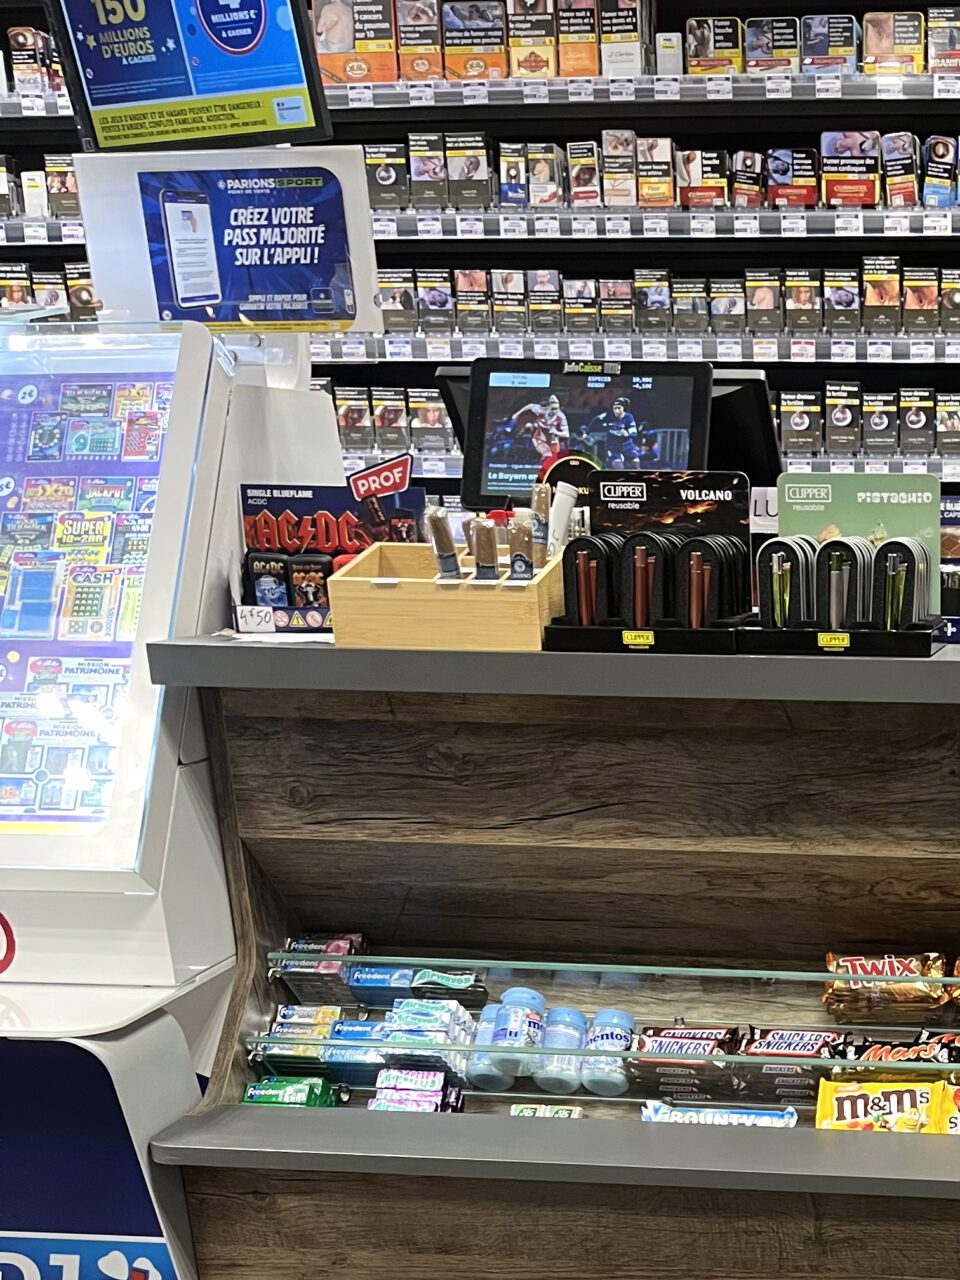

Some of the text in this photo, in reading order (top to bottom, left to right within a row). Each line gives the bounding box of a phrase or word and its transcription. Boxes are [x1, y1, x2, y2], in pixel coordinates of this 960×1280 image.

[211, 11, 249, 23] MILLIONS
[100, 26, 151, 43] MILLIONS
[226, 178, 322, 189] PARIONS SPORT
[230, 206, 314, 226] CRÉEZ VOTRE
[224, 224, 325, 246] PASS MAJORITÉ
[234, 248, 261, 266] SUR
[263, 247, 311, 265] L'APPLI
[563, 362, 603, 374] InfoCaisse
[357, 466, 404, 495] PROF
[488, 472, 498, 480] Le
[498, 472, 527, 481] Bayern
[246, 489, 314, 498] SINGLE BLUEFLAME
[603, 485, 643, 498] CLIPPER
[680, 489, 732, 501] VOLCANO
[788, 487, 829, 500] CLIPPER
[607, 502, 640, 510] reusable
[792, 503, 825, 511] reusable
[64, 520, 104, 536] SUPER
[72, 572, 115, 584] CASH
[625, 633, 651, 643] CLIPPER
[820, 636, 847, 644] CLIPPER
[64, 666, 121, 675] PATRIMOINE
[39, 730, 96, 738] PATRIMOINE
[290, 941, 327, 951] Freedent
[353, 970, 391, 980] Freedent
[275, 1024, 313, 1034] Freedent
[334, 1023, 372, 1033] Freedent
[651, 1038, 711, 1056] SNICKERS
[754, 1040, 819, 1052] SNICKERS
[860, 1043, 938, 1062] Mars
[247, 1086, 285, 1097] Freedent
